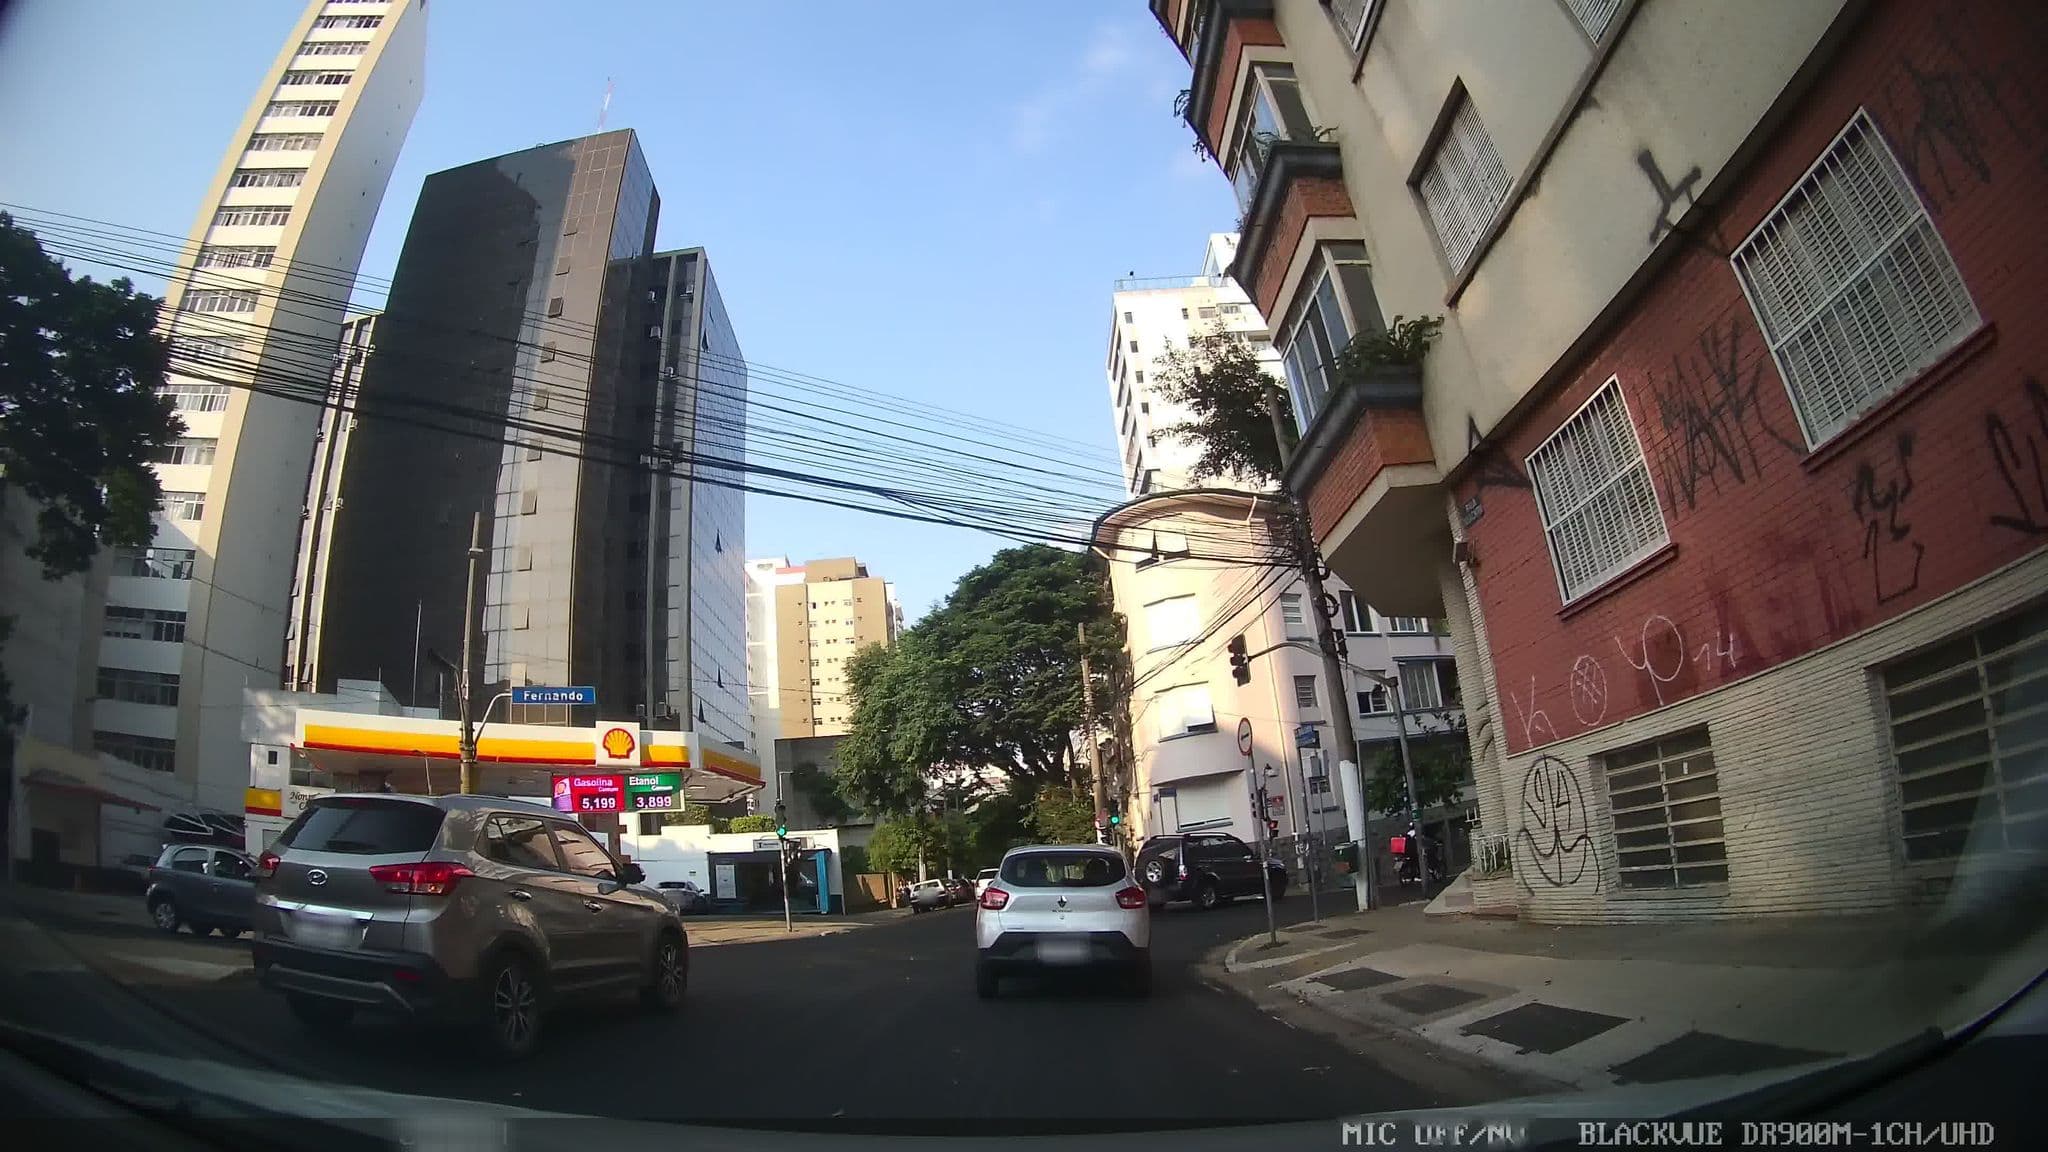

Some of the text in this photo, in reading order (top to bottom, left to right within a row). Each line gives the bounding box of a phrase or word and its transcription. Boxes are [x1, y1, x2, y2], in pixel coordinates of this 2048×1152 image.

[523, 690, 584, 701] Fernando
[573, 778, 613, 787] Gasolina
[628, 775, 659, 786] Etanol
[582, 797, 616, 811] 5,199
[636, 796, 672, 809] 3,899
